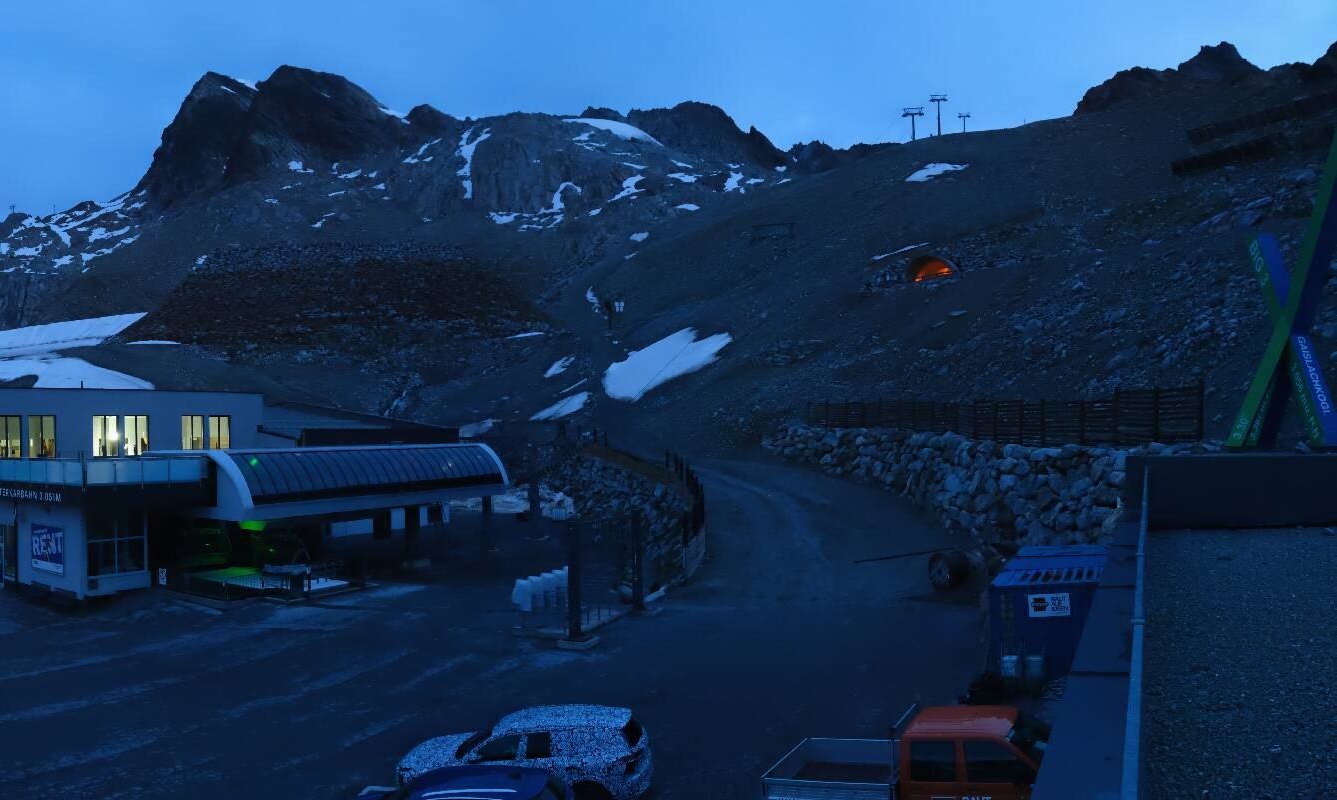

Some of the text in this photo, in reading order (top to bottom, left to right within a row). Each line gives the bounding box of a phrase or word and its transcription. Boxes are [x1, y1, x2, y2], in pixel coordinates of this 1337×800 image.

[1249, 239, 1264, 272] BIG
[1297, 336, 1331, 416] GAISLACHKOGL
[32, 532, 64, 556] RENT
